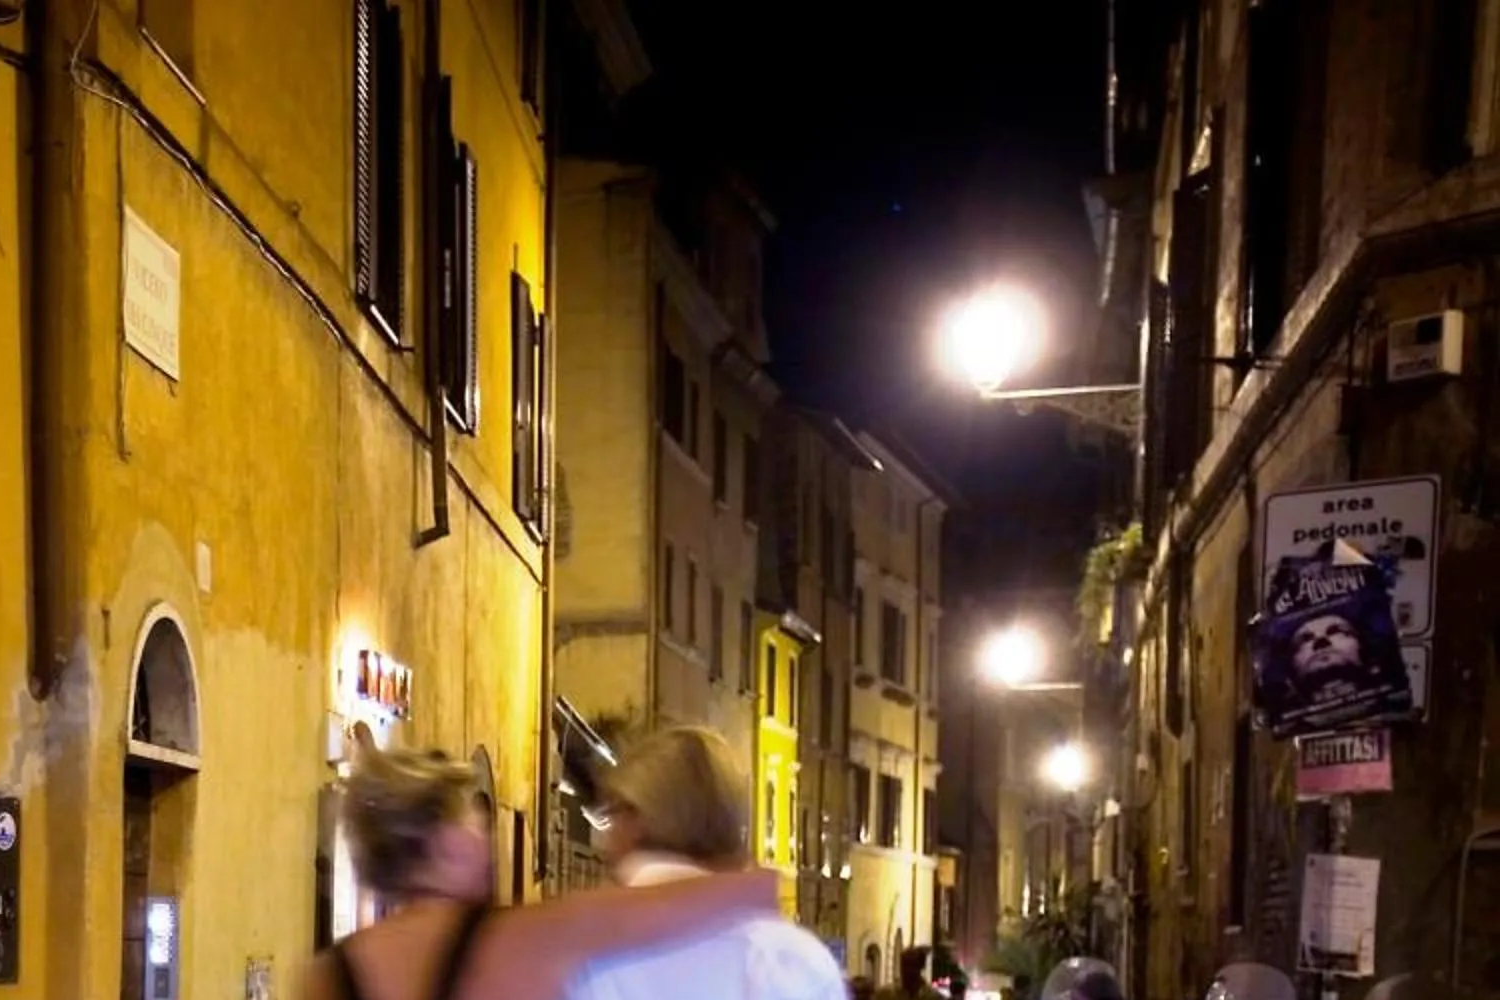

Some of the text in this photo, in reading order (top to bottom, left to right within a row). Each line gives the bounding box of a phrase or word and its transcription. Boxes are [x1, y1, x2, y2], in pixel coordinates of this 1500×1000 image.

[1323, 496, 1374, 513] area
[1293, 517, 1403, 543] pedonale
[1306, 735, 1380, 766] AFFITTASI
